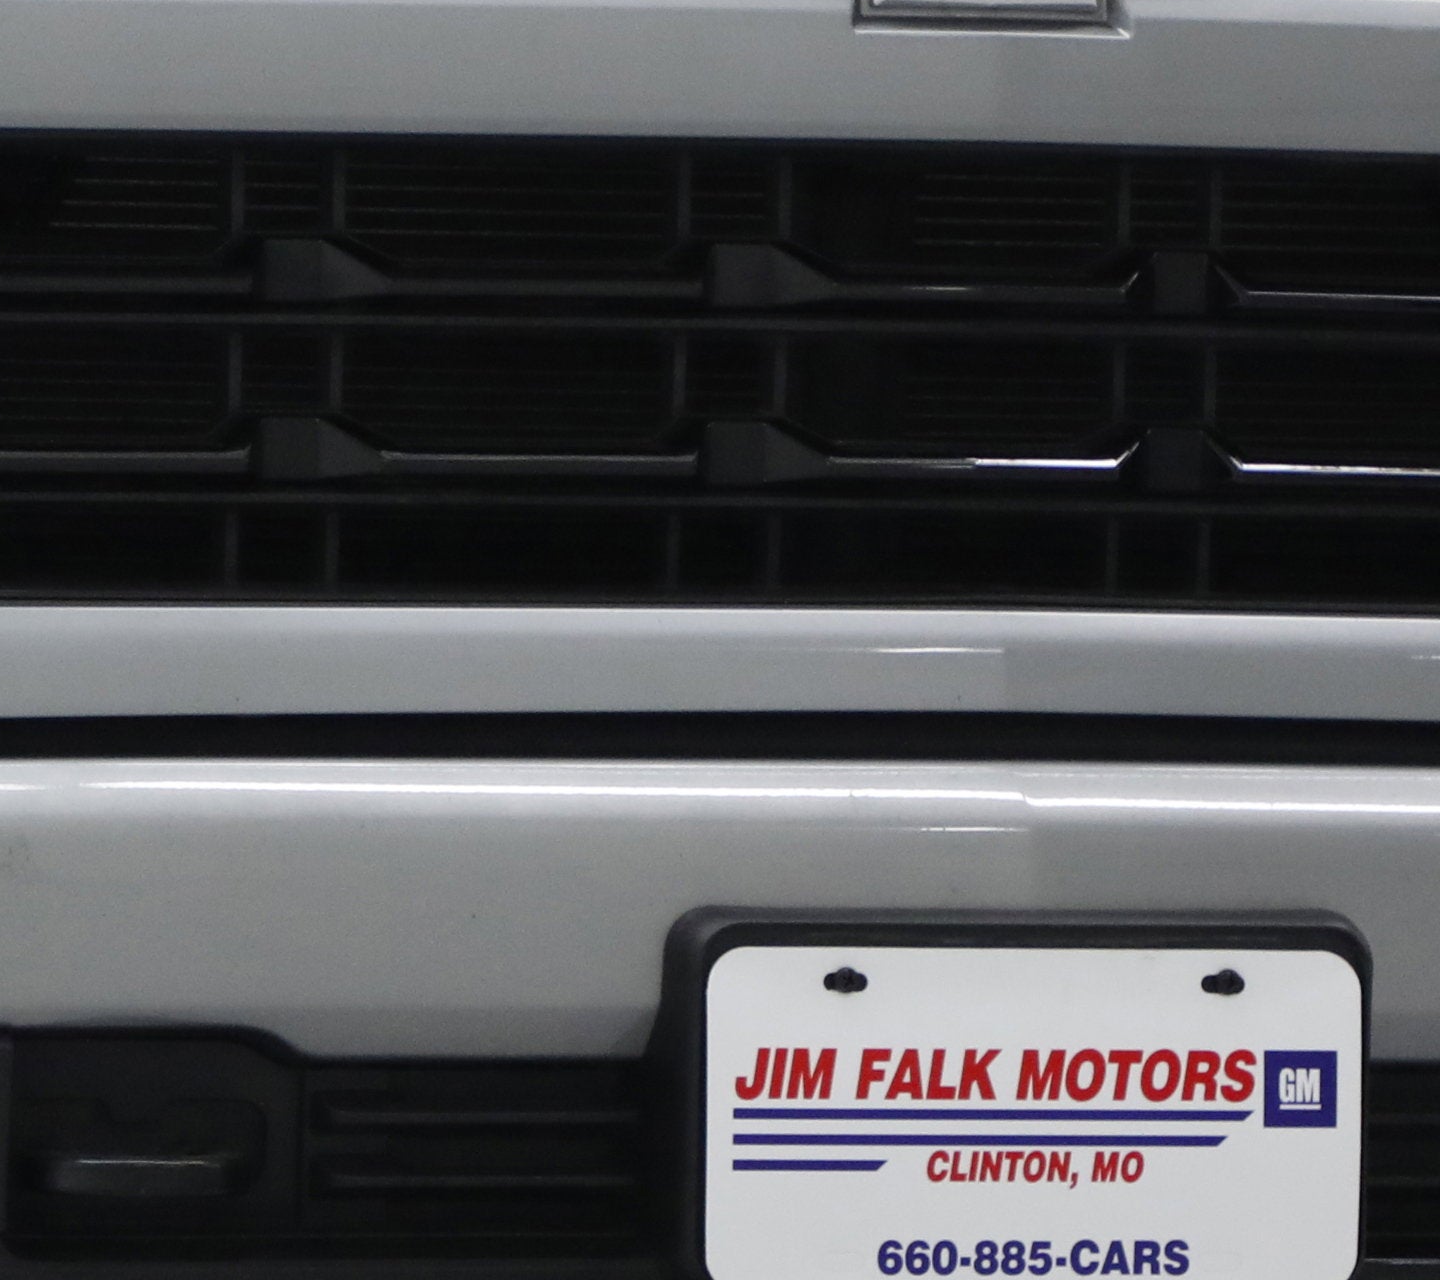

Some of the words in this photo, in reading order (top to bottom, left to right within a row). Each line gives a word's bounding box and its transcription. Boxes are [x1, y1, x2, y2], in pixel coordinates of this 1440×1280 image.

[734, 1047, 838, 1102] JIM
[855, 1048, 1001, 1102] FALK
[1016, 1049, 1257, 1103] MOTORS
[1278, 1067, 1321, 1105] GM
[926, 1150, 1079, 1189] CLINTON,
[1091, 1150, 1145, 1184] MO
[877, 1239, 1190, 1277] 660-885-CARS
